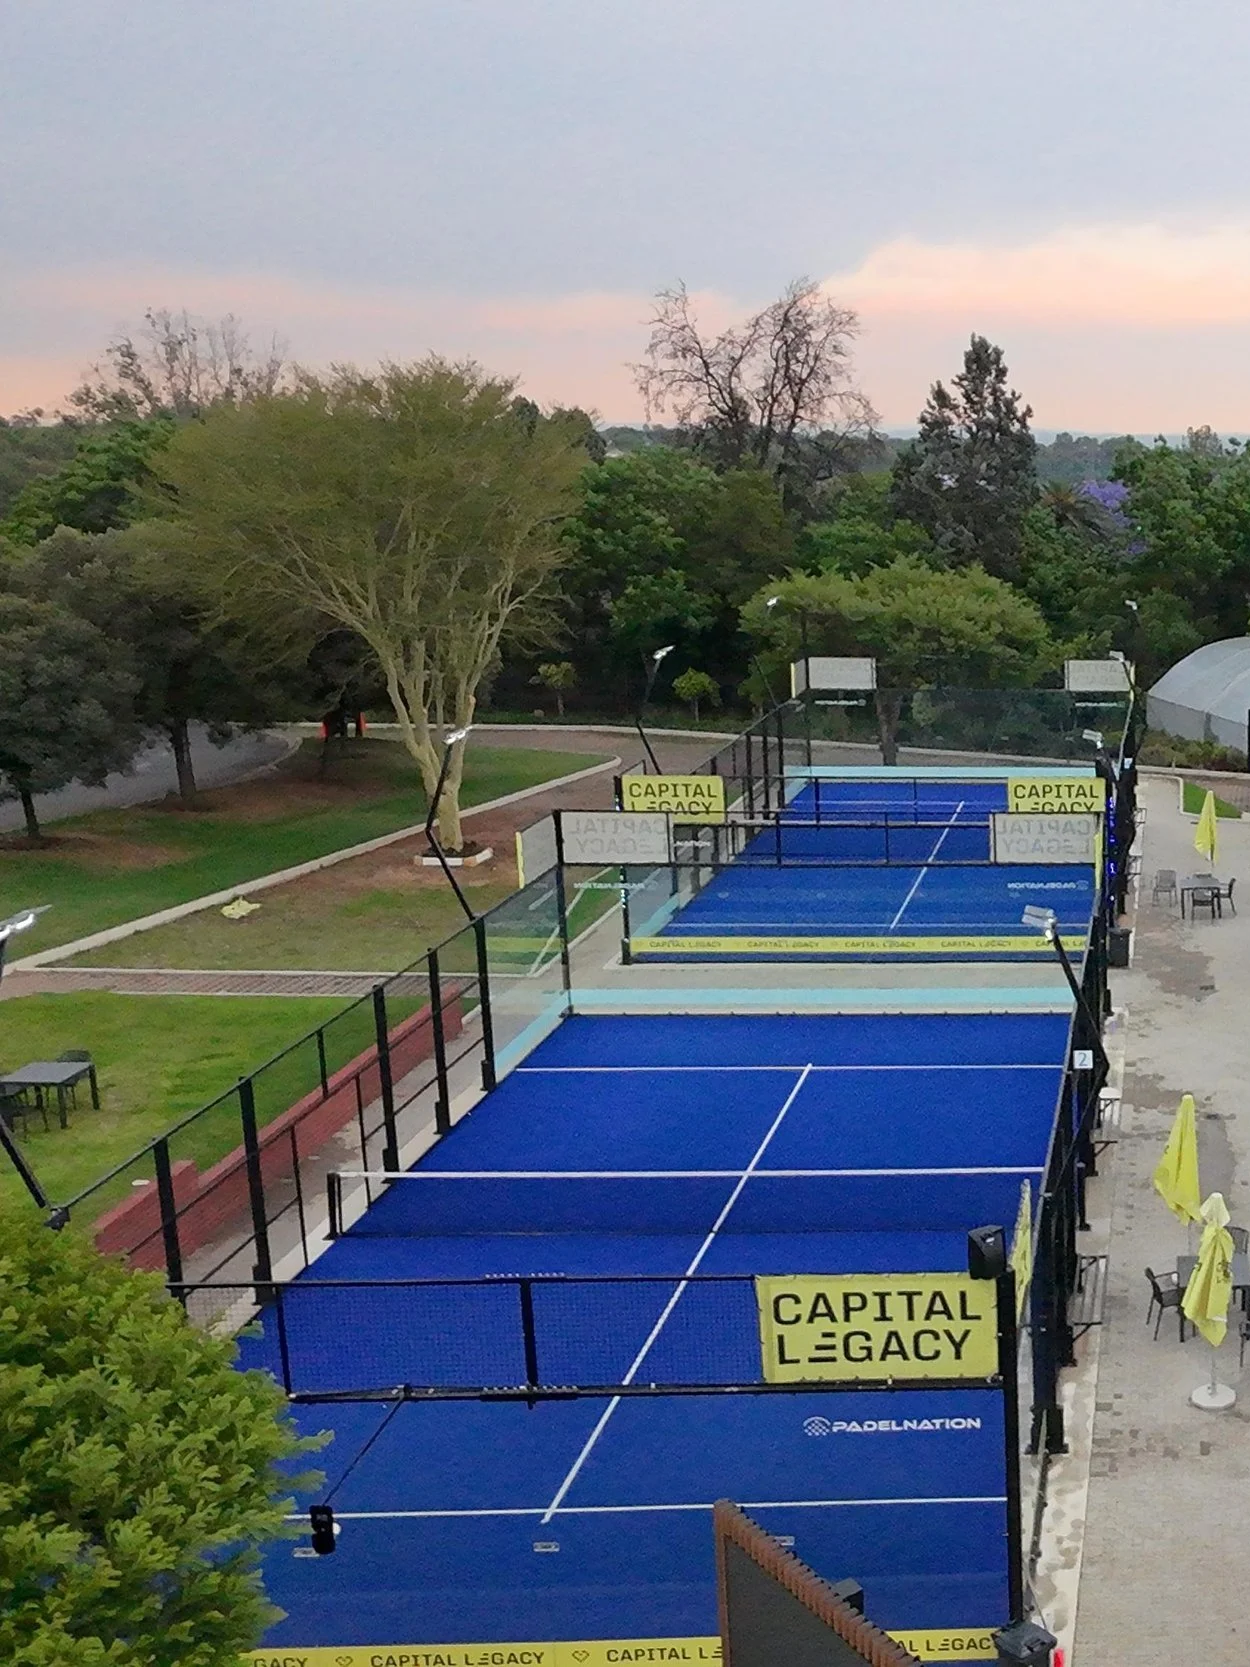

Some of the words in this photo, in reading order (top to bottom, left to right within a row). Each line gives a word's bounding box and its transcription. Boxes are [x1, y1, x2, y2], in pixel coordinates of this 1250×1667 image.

[629, 782, 717, 798] CAPITAL
[1013, 784, 1099, 799] CAPITAL
[1078, 1052, 1088, 1067] 2
[773, 1290, 982, 1325] CAPITAL
[777, 1329, 971, 1365] LEGACY
[832, 1417, 982, 1432] PADELNATION
[926, 1637, 991, 1652] LEGAC
[370, 1653, 457, 1667] CAPITAL
[464, 1651, 545, 1666] LEGACY
[606, 1647, 691, 1662] CAPITAL
